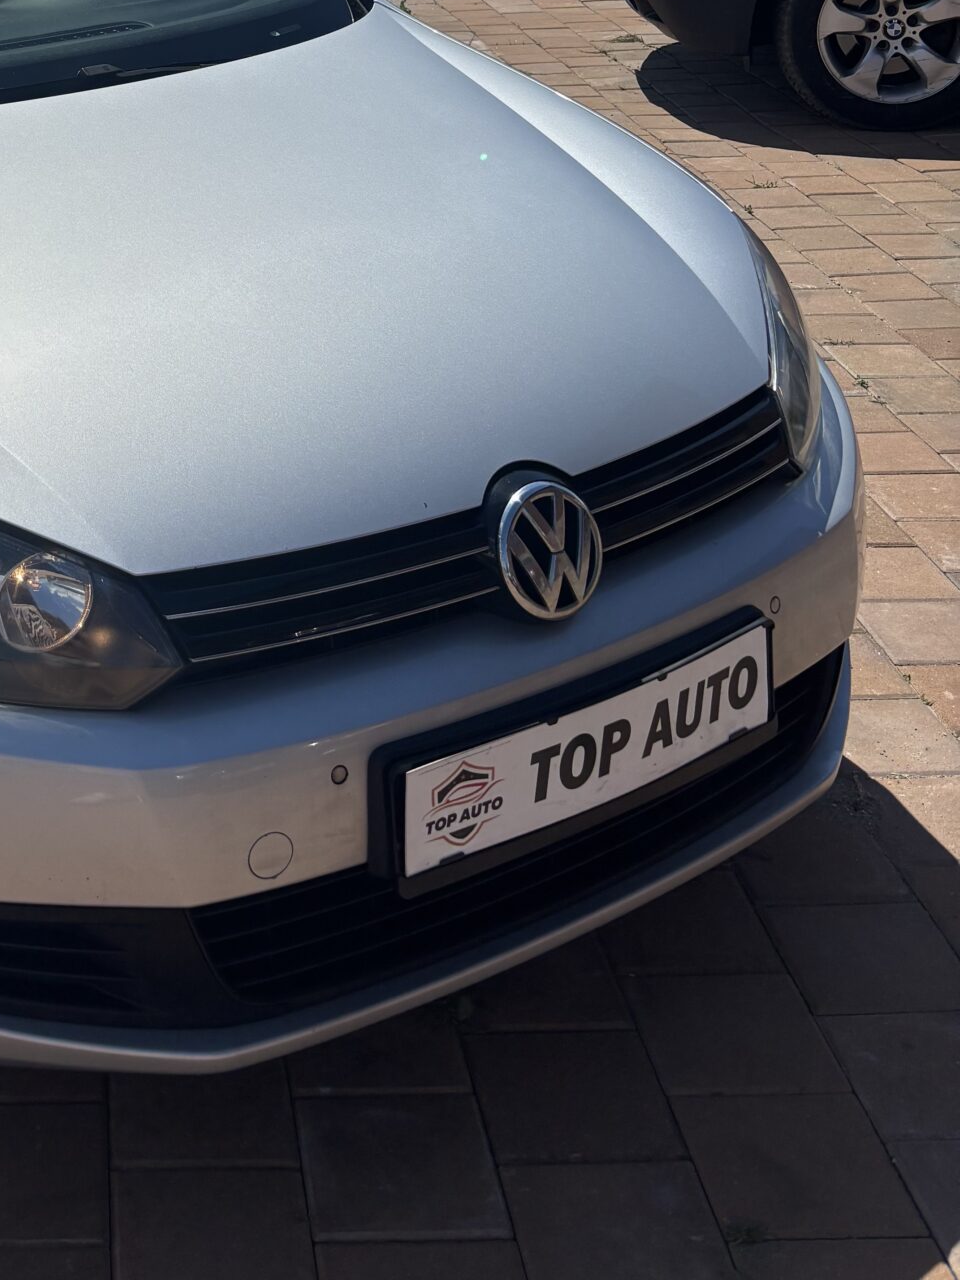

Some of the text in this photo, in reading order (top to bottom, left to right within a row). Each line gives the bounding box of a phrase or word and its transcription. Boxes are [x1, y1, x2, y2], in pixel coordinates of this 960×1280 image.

[530, 655, 758, 803] TOP AUTO
[425, 795, 504, 835] TOP AUTO
